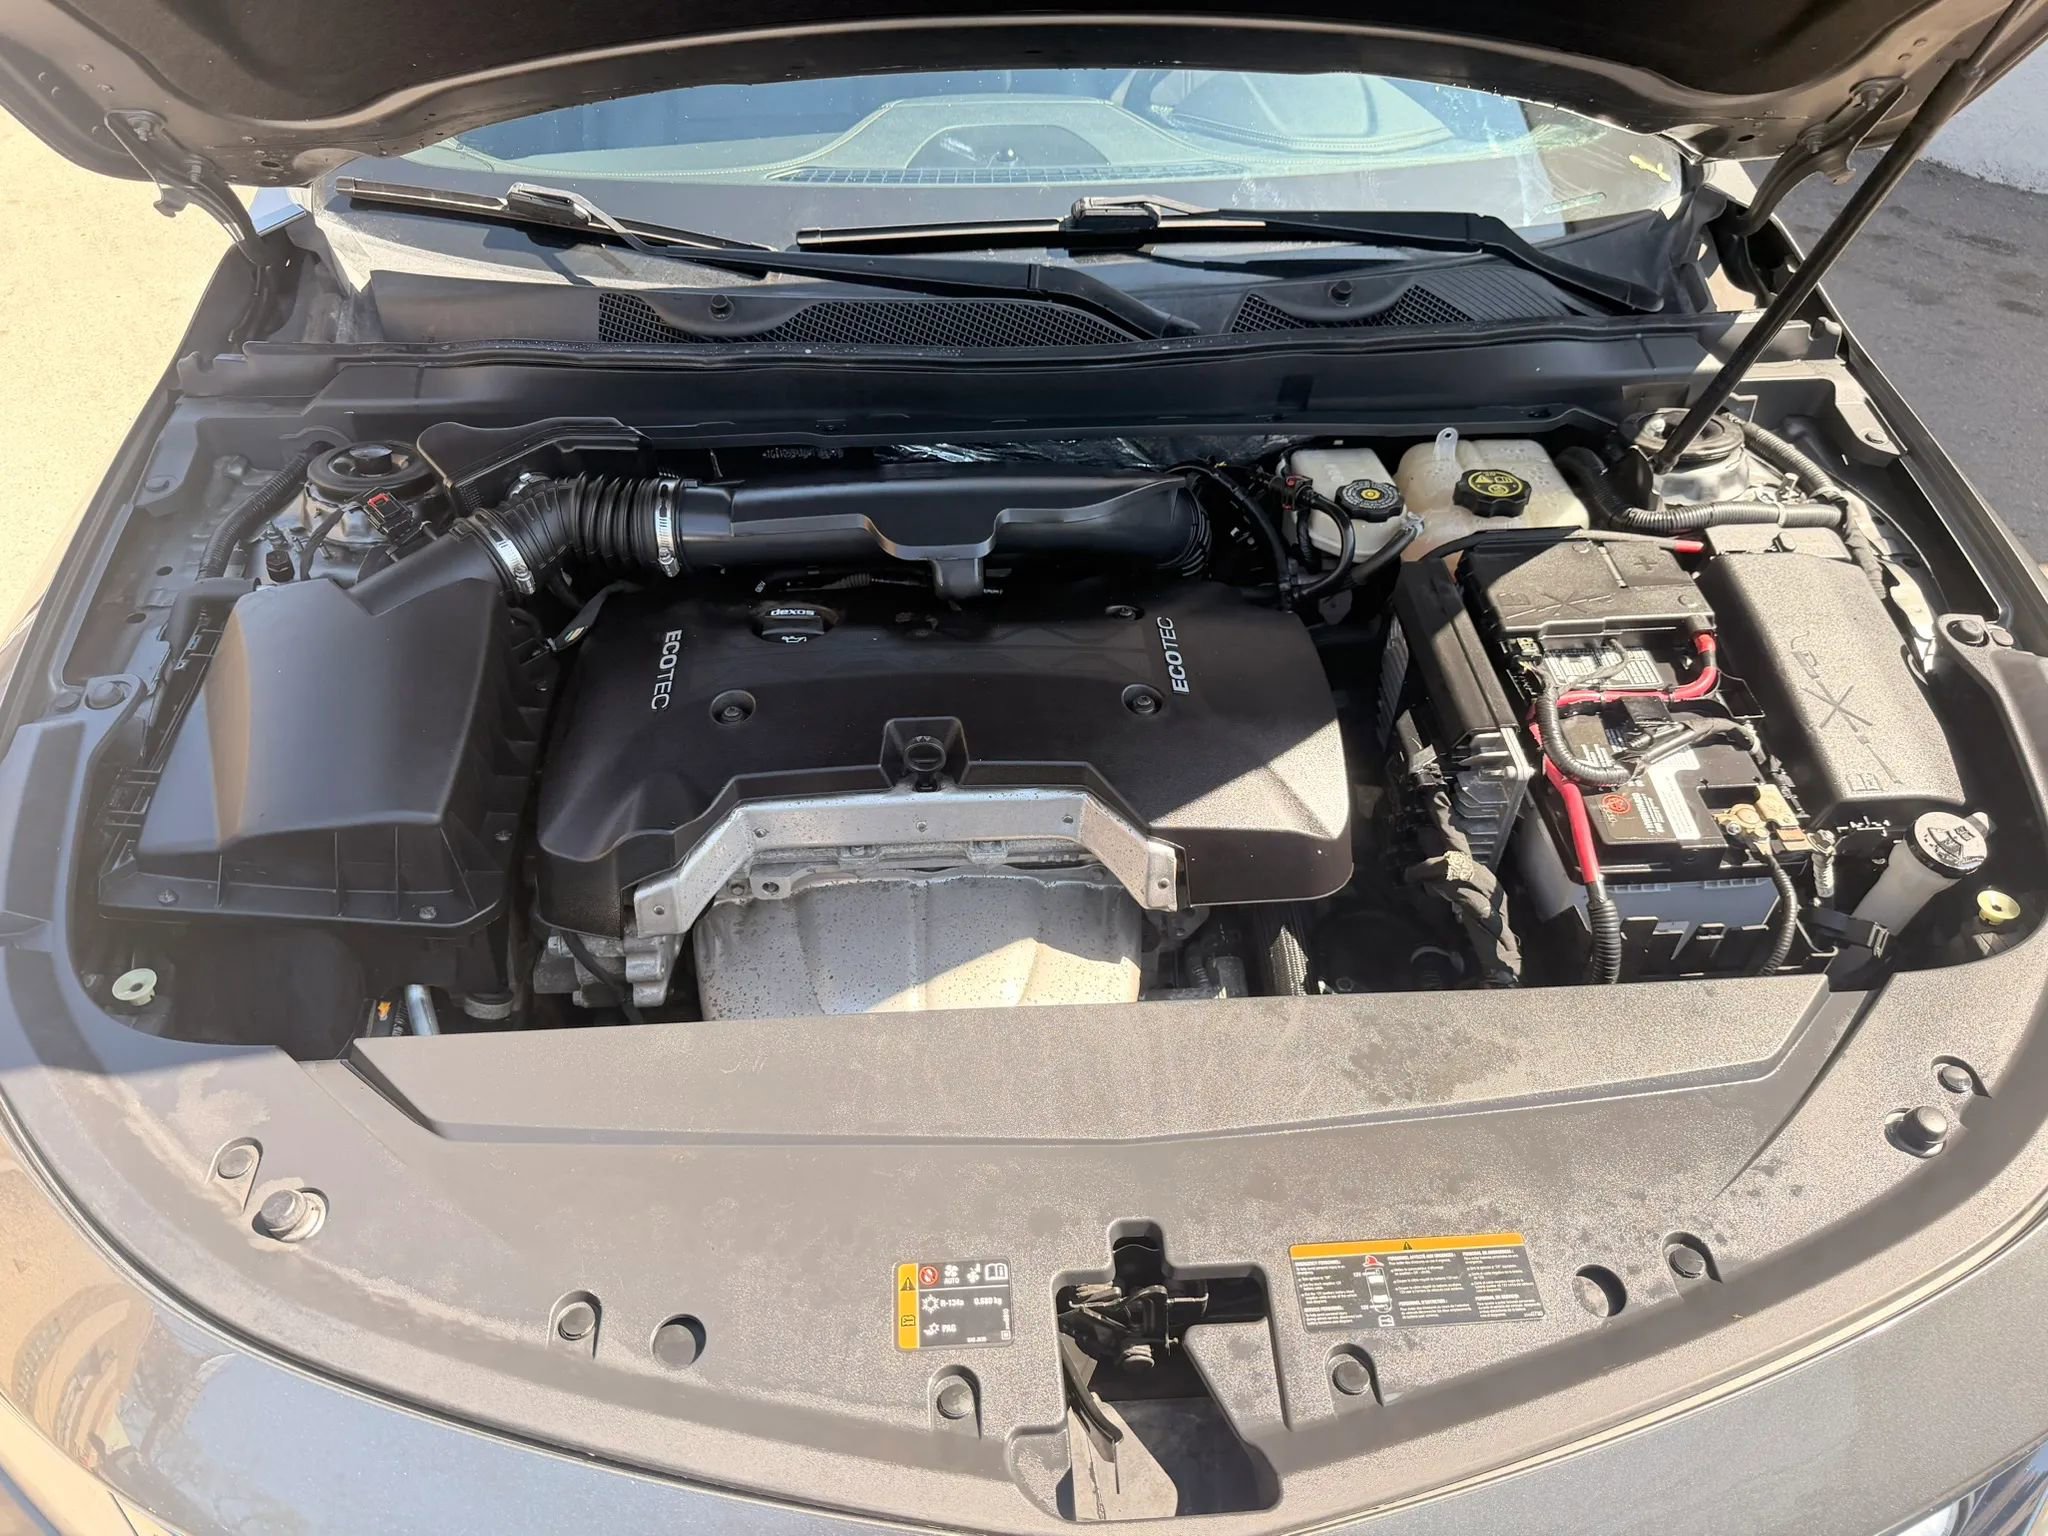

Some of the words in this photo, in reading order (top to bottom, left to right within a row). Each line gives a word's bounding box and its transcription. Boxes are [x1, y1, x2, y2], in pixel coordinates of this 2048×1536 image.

[770, 608, 815, 616] dexos
[1156, 616, 1190, 694] ECOTEC
[651, 629, 683, 710] ECOTEC
[944, 1277, 960, 1285] AUTO
[941, 1324, 957, 1333] PAG
